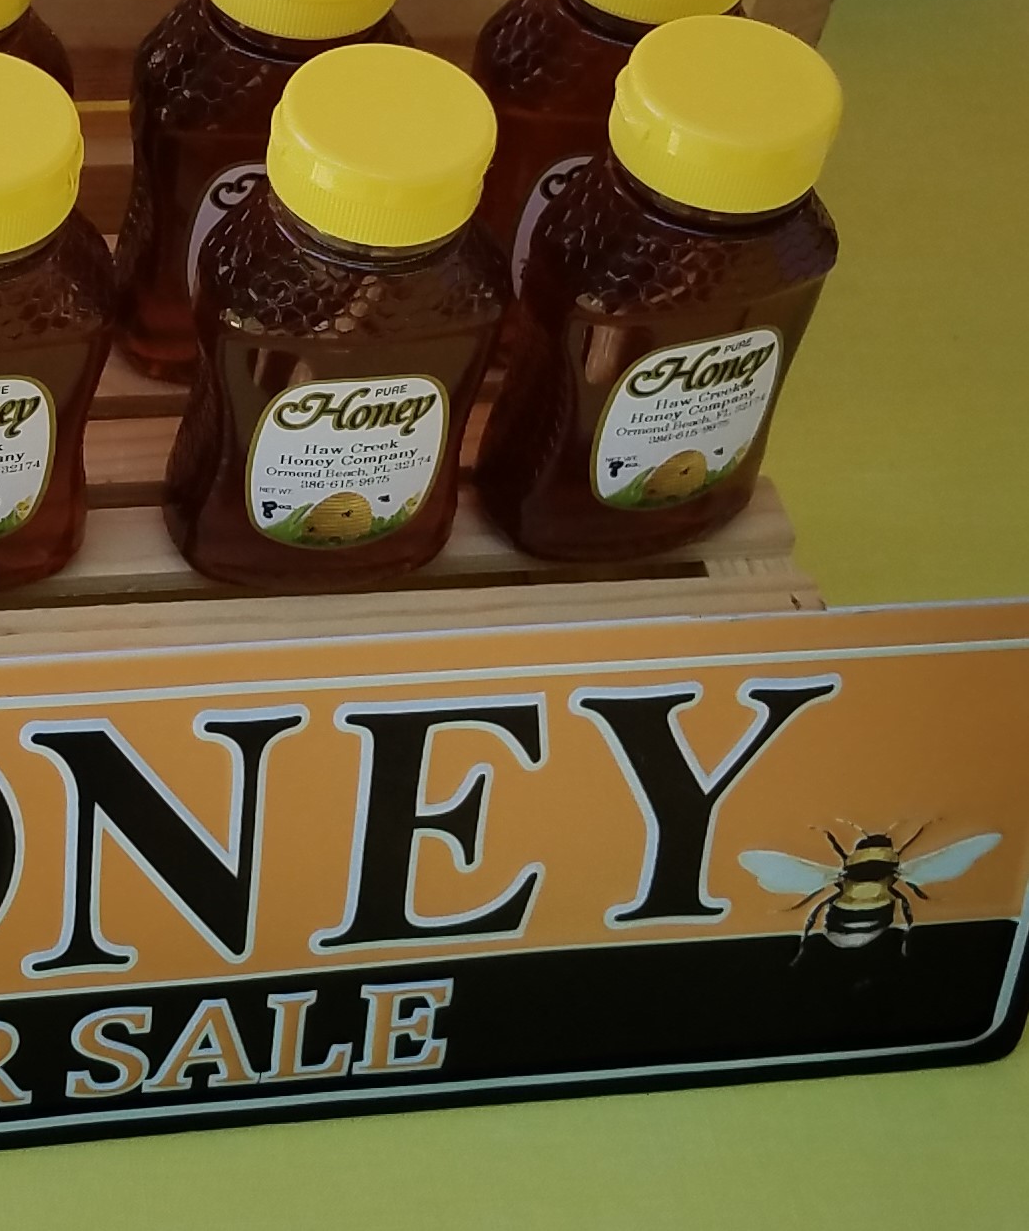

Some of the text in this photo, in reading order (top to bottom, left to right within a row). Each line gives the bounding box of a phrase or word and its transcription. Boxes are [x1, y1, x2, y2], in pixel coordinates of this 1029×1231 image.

[723, 337, 753, 355] PURE
[626, 341, 775, 399] Honey
[375, 385, 407, 398] PURE
[273, 388, 437, 436] Honey
[630, 390, 756, 424] Honey Company
[655, 399, 691, 410] Haw
[616, 423, 669, 437] Ormond
[305, 440, 399, 455] Haw Creek
[280, 448, 419, 469] Honey Company
[266, 467, 321, 478] Ormond
[373, 465, 390, 475] FL
[66, 978, 455, 1098] SALE
